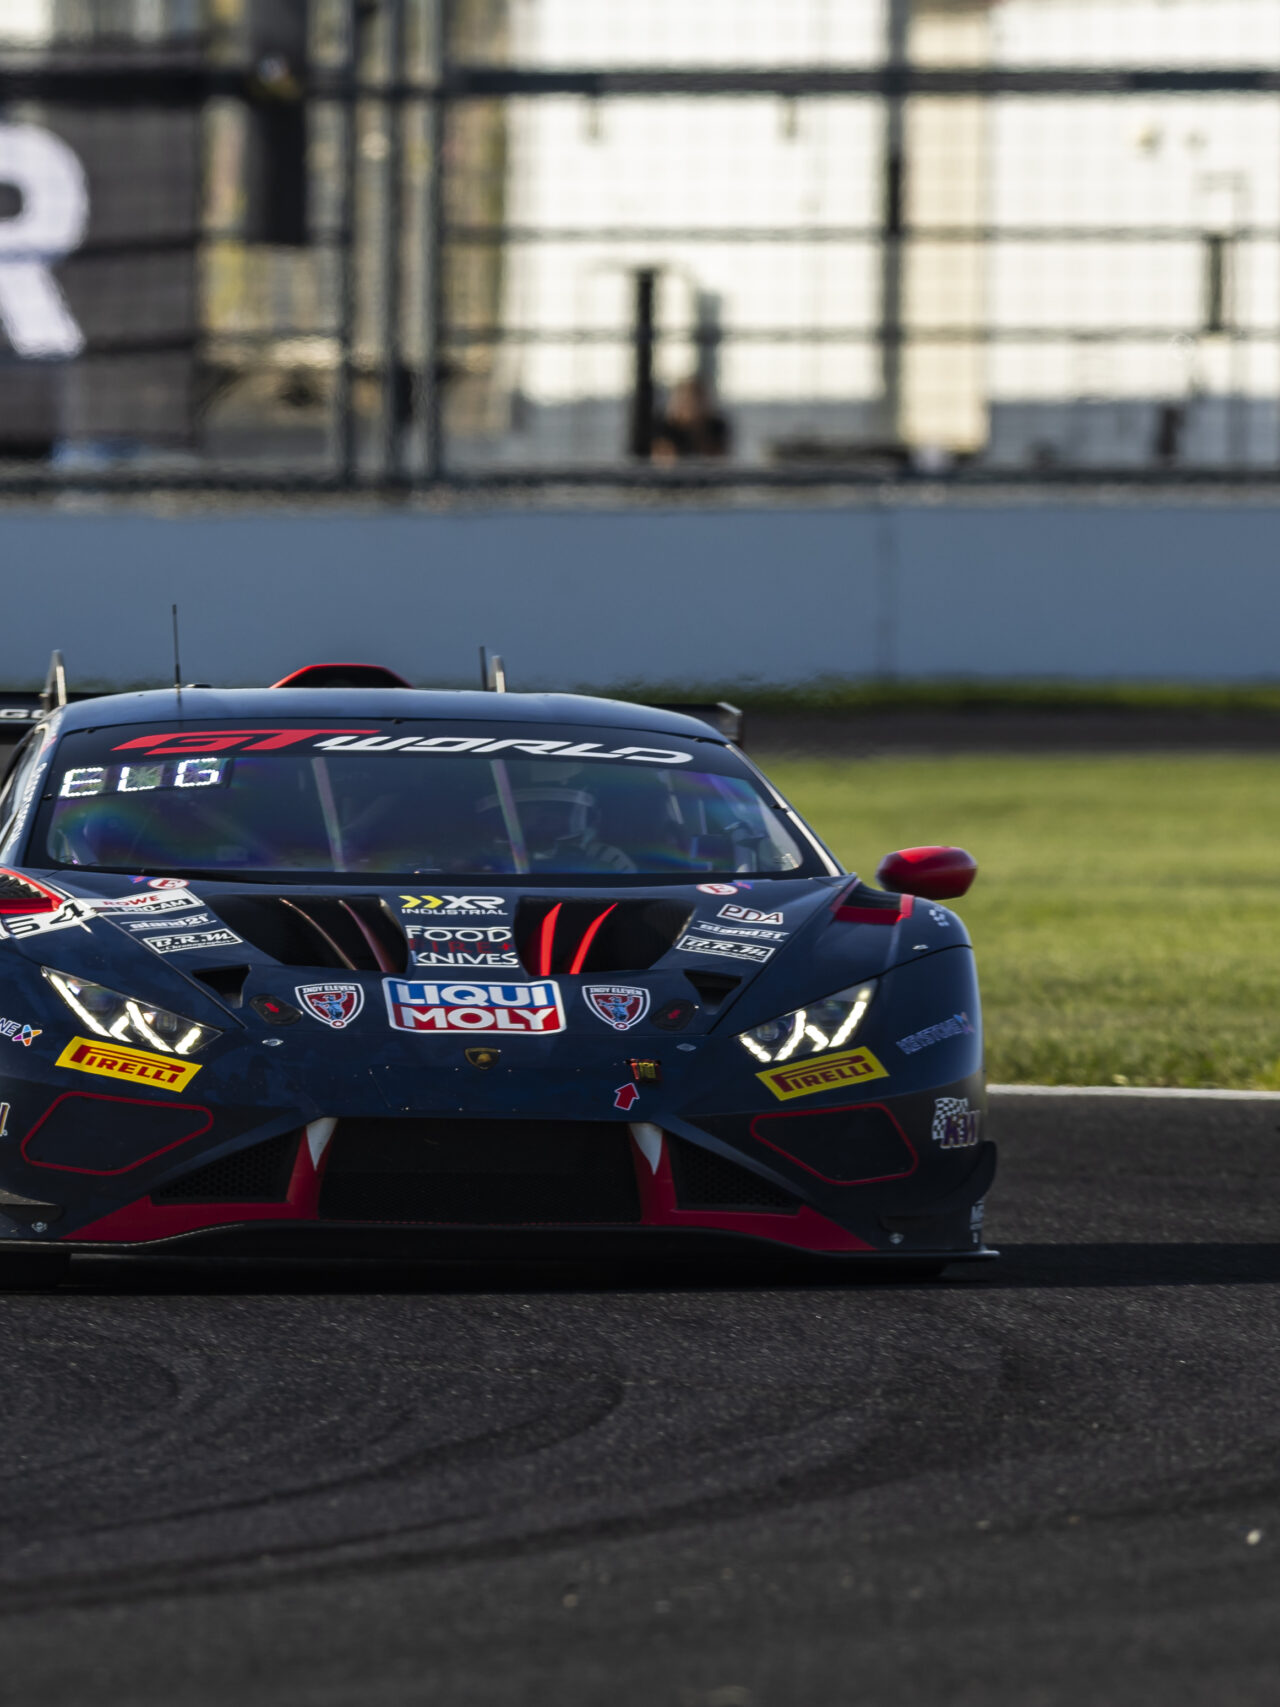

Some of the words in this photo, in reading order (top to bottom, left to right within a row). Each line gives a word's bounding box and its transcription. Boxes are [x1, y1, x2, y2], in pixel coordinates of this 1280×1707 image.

[109, 728, 382, 756] GT
[312, 736, 694, 764] WORLD
[59, 757, 219, 798] ELG
[103, 895, 160, 907] ROWE
[121, 899, 188, 912] PRO-AM
[441, 895, 505, 909] XR
[2, 901, 85, 936] 54
[401, 908, 509, 916] INDUSTRIAL
[721, 905, 781, 923] PDA
[405, 927, 512, 942] FOOD
[410, 952, 519, 965] KNIVES
[396, 983, 549, 1006] LIQUI
[400, 1007, 556, 1030] MOLY
[70, 1044, 186, 1083] PIRELLI
[770, 1055, 875, 1092] PIRELLI
